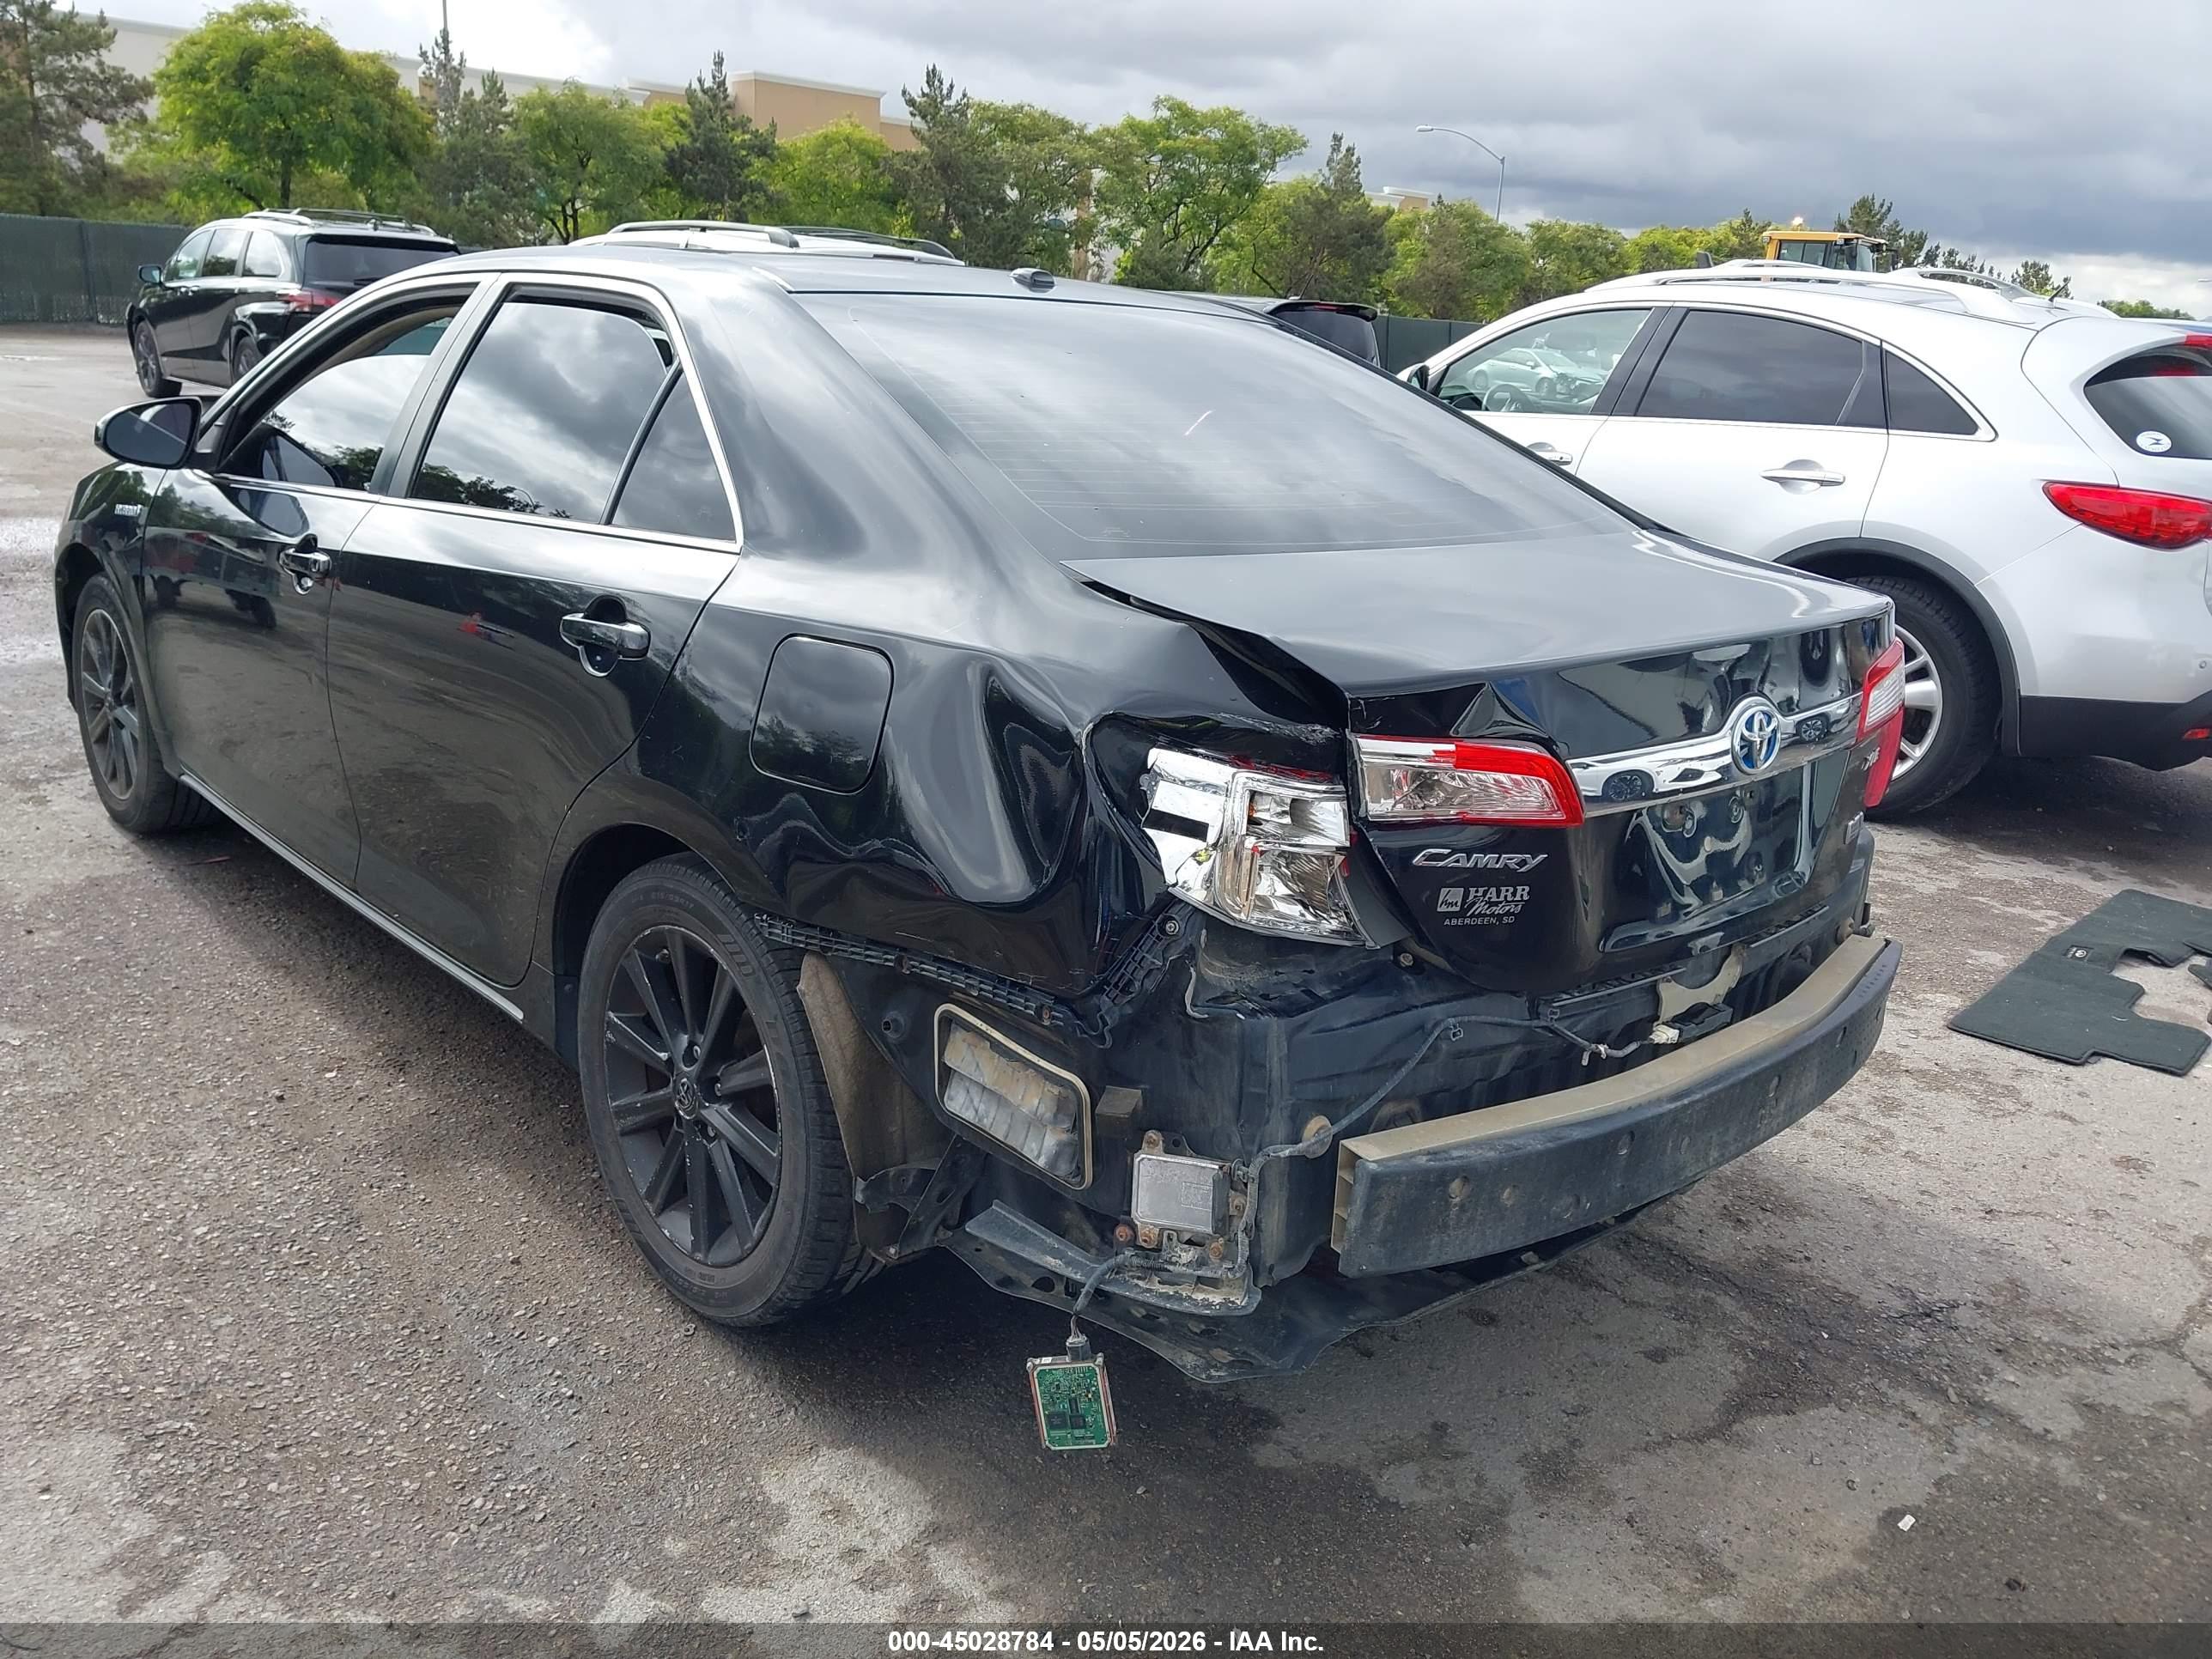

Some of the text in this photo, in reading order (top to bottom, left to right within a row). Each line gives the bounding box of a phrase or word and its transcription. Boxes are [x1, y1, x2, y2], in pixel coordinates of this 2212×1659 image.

[1413, 848, 1548, 872] CAMRY
[1467, 885, 1530, 901] HARR
[1464, 897, 1525, 916] Motors
[1443, 915, 1516, 926] ABERDEEN, SD
